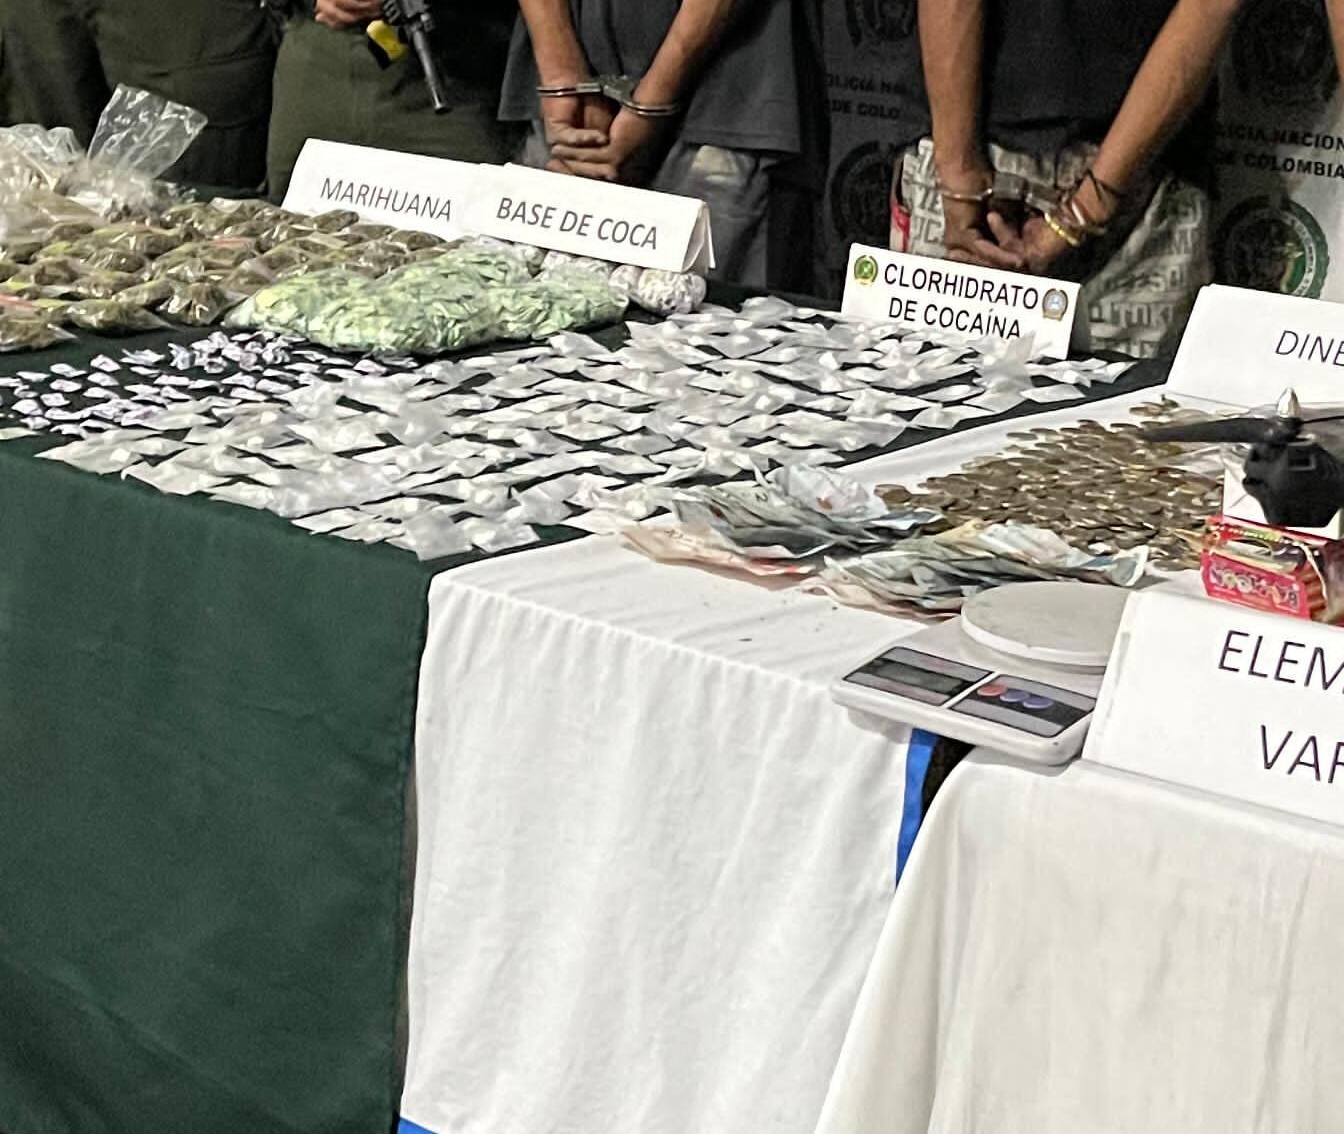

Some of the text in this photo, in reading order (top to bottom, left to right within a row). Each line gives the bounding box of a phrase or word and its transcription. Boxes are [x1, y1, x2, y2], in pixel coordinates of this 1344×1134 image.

[319, 176, 452, 222] MARIHUANA
[495, 196, 658, 251] BASE DE COCA
[883, 262, 1039, 310] CLORHIDRATO
[888, 297, 1021, 340] DE COCAÍNA
